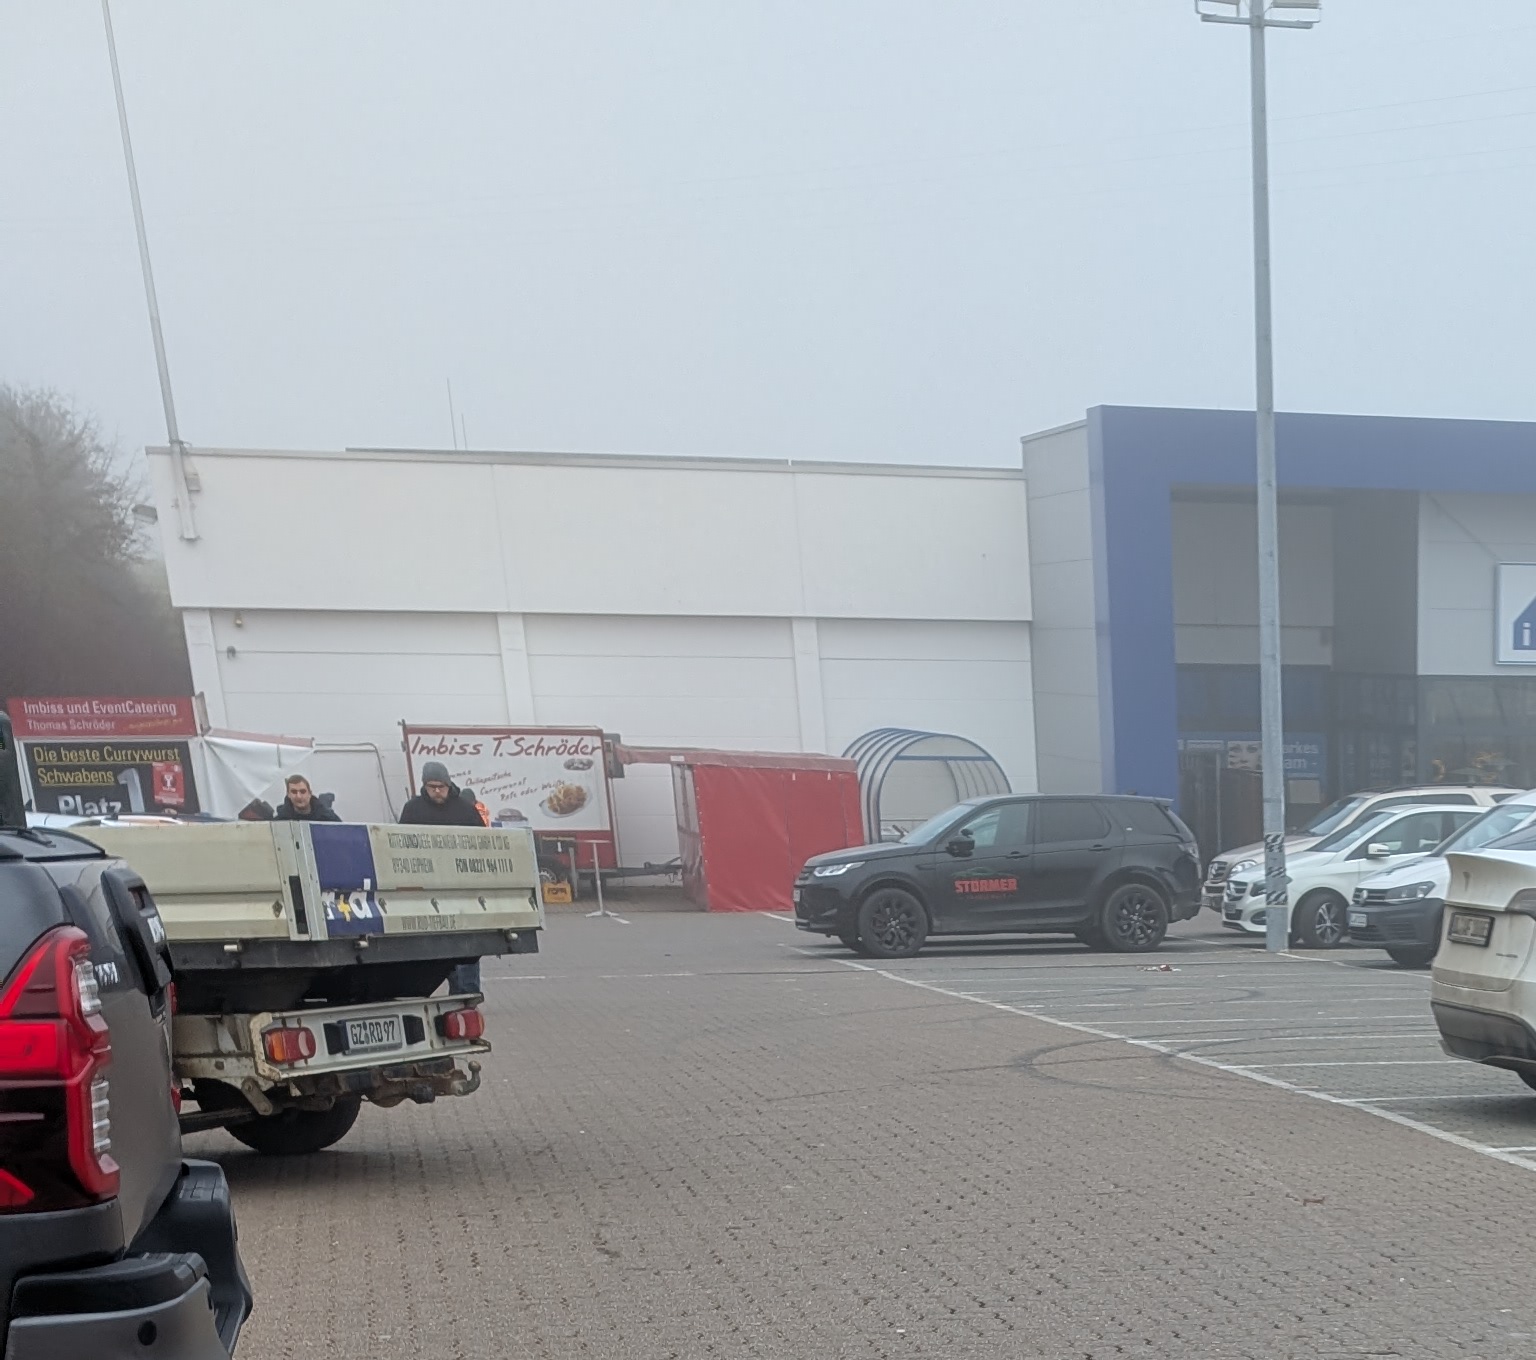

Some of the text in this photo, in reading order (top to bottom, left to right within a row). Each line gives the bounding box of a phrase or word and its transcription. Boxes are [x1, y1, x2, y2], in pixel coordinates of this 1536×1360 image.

[24, 700, 177, 716] Imbiss und EventCatering
[27, 719, 67, 731] Thomas
[69, 718, 116, 731] Schröder
[410, 735, 484, 756] Imbiss
[33, 746, 180, 764] Die beste Currywurst
[37, 767, 115, 784] Schwabens
[57, 795, 122, 815] Platz
[117, 767, 146, 814] 1
[350, 1023, 364, 1045] GZ
